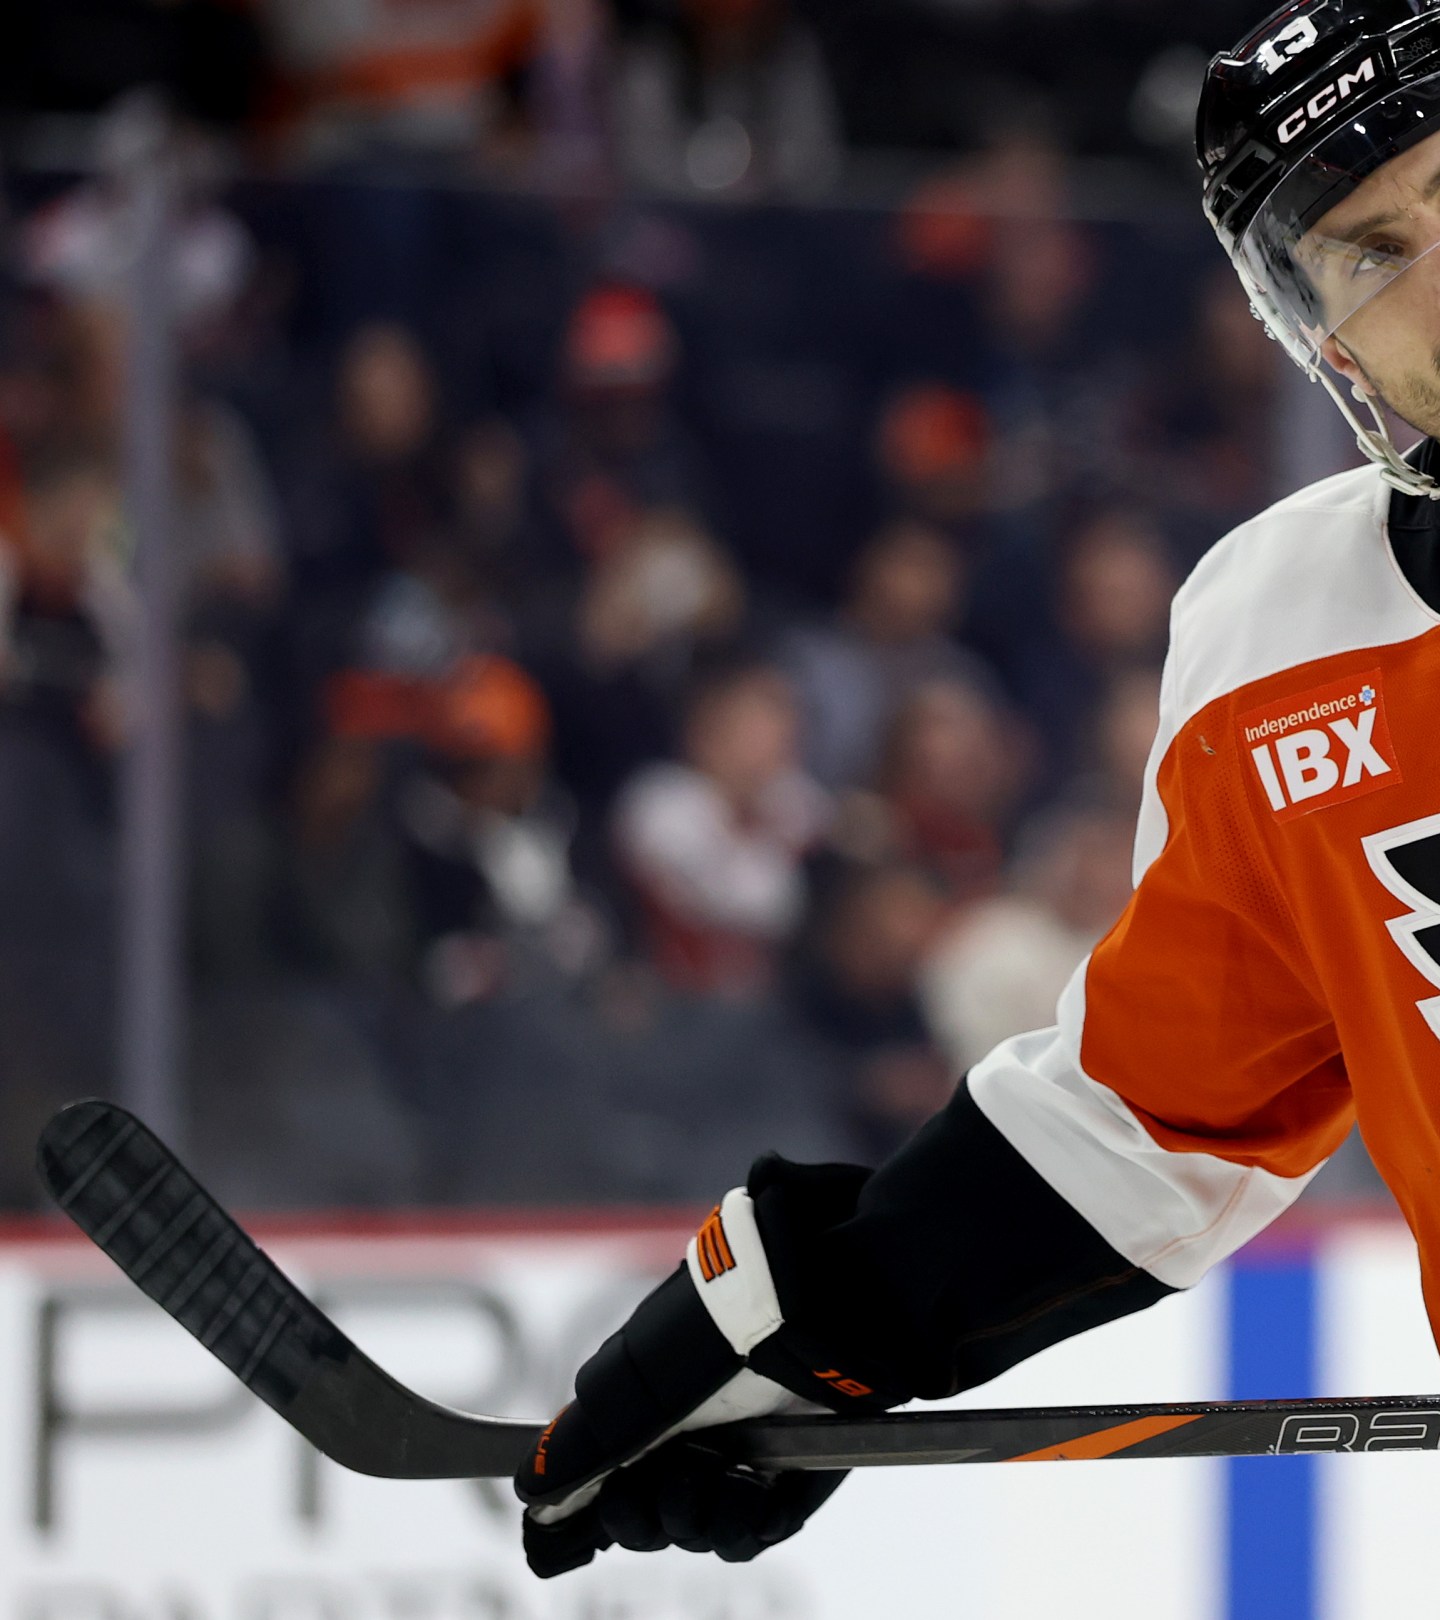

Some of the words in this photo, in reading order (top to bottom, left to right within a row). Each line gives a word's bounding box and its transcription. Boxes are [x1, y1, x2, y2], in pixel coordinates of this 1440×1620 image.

[1276, 56, 1376, 145] CCM
[1244, 693, 1357, 743] Independence
[1251, 706, 1393, 813] IBX
[812, 1368, 873, 1397] 19
